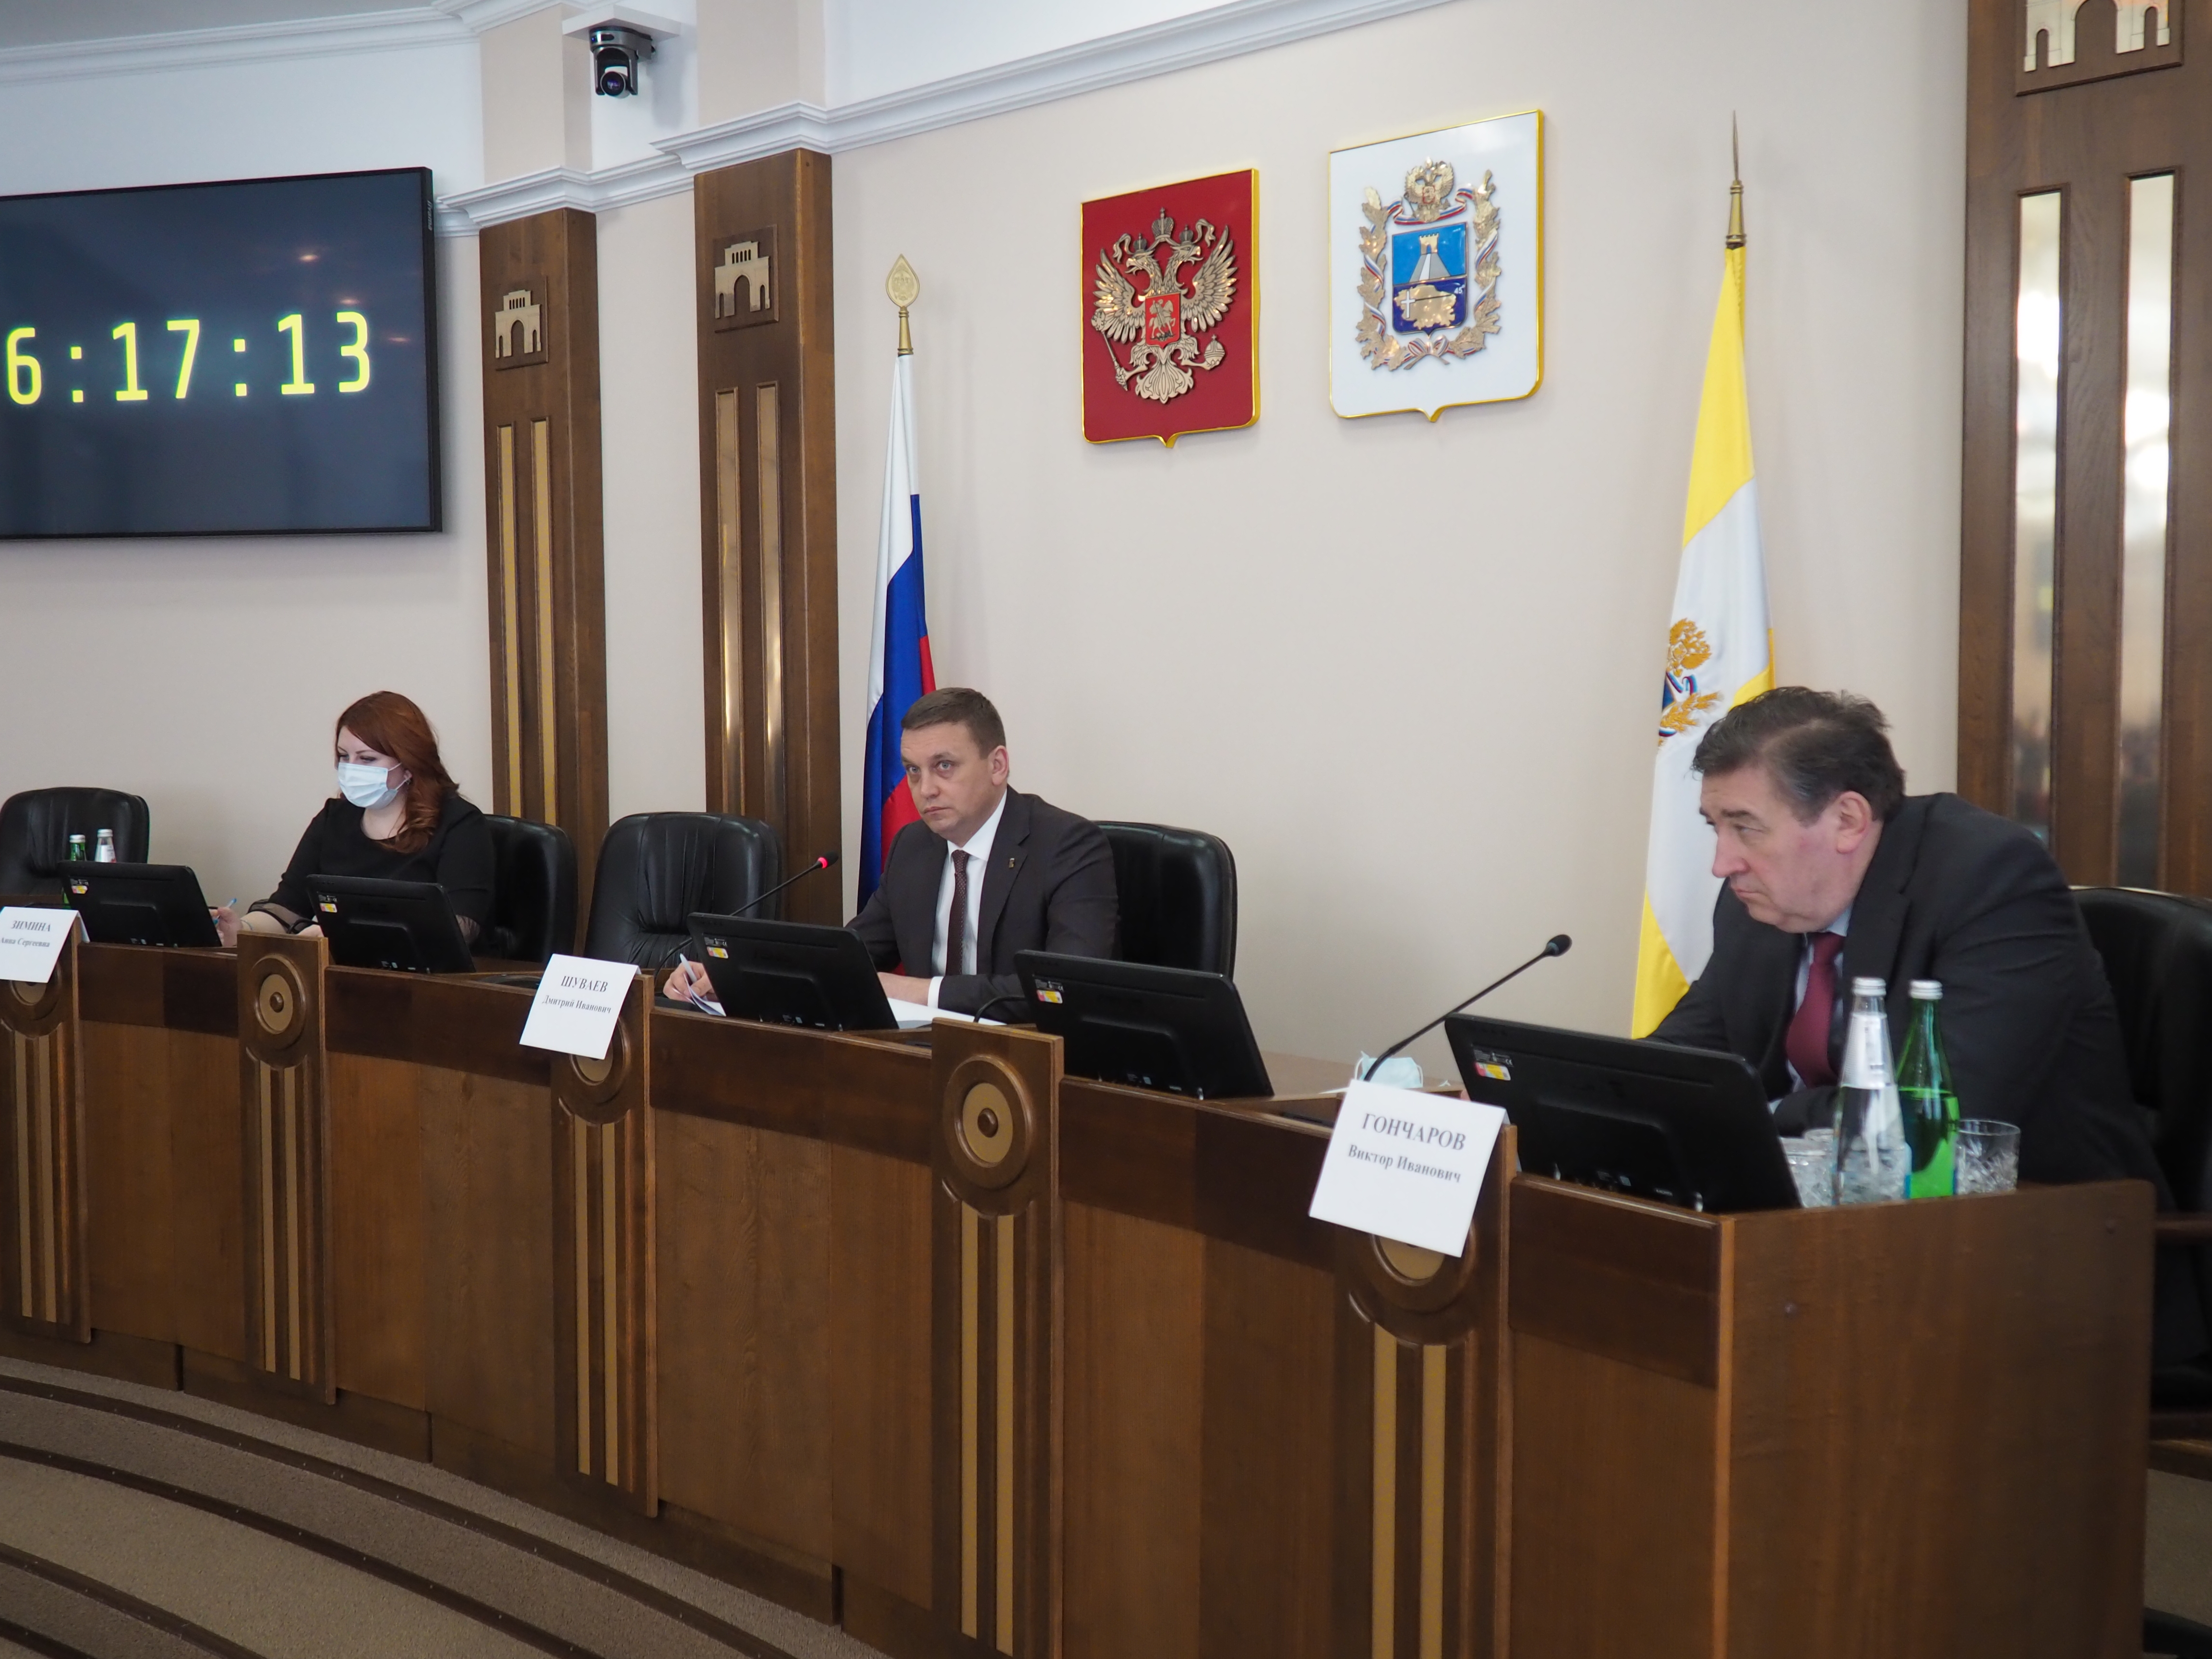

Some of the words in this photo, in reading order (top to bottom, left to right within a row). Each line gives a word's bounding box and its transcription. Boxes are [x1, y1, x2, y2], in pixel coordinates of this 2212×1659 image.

[11, 920, 51, 932] ЗИМИНА
[17, 938, 50, 947] Сергеевна
[561, 975, 608, 992] ШУВАЕВ
[541, 995, 575, 1009] Дмитрий
[576, 1000, 612, 1014] Иванович
[1362, 1113, 1467, 1150] ГОНЧАРОВ
[1348, 1144, 1393, 1169] Виктор
[1396, 1155, 1461, 1183] Иванович
